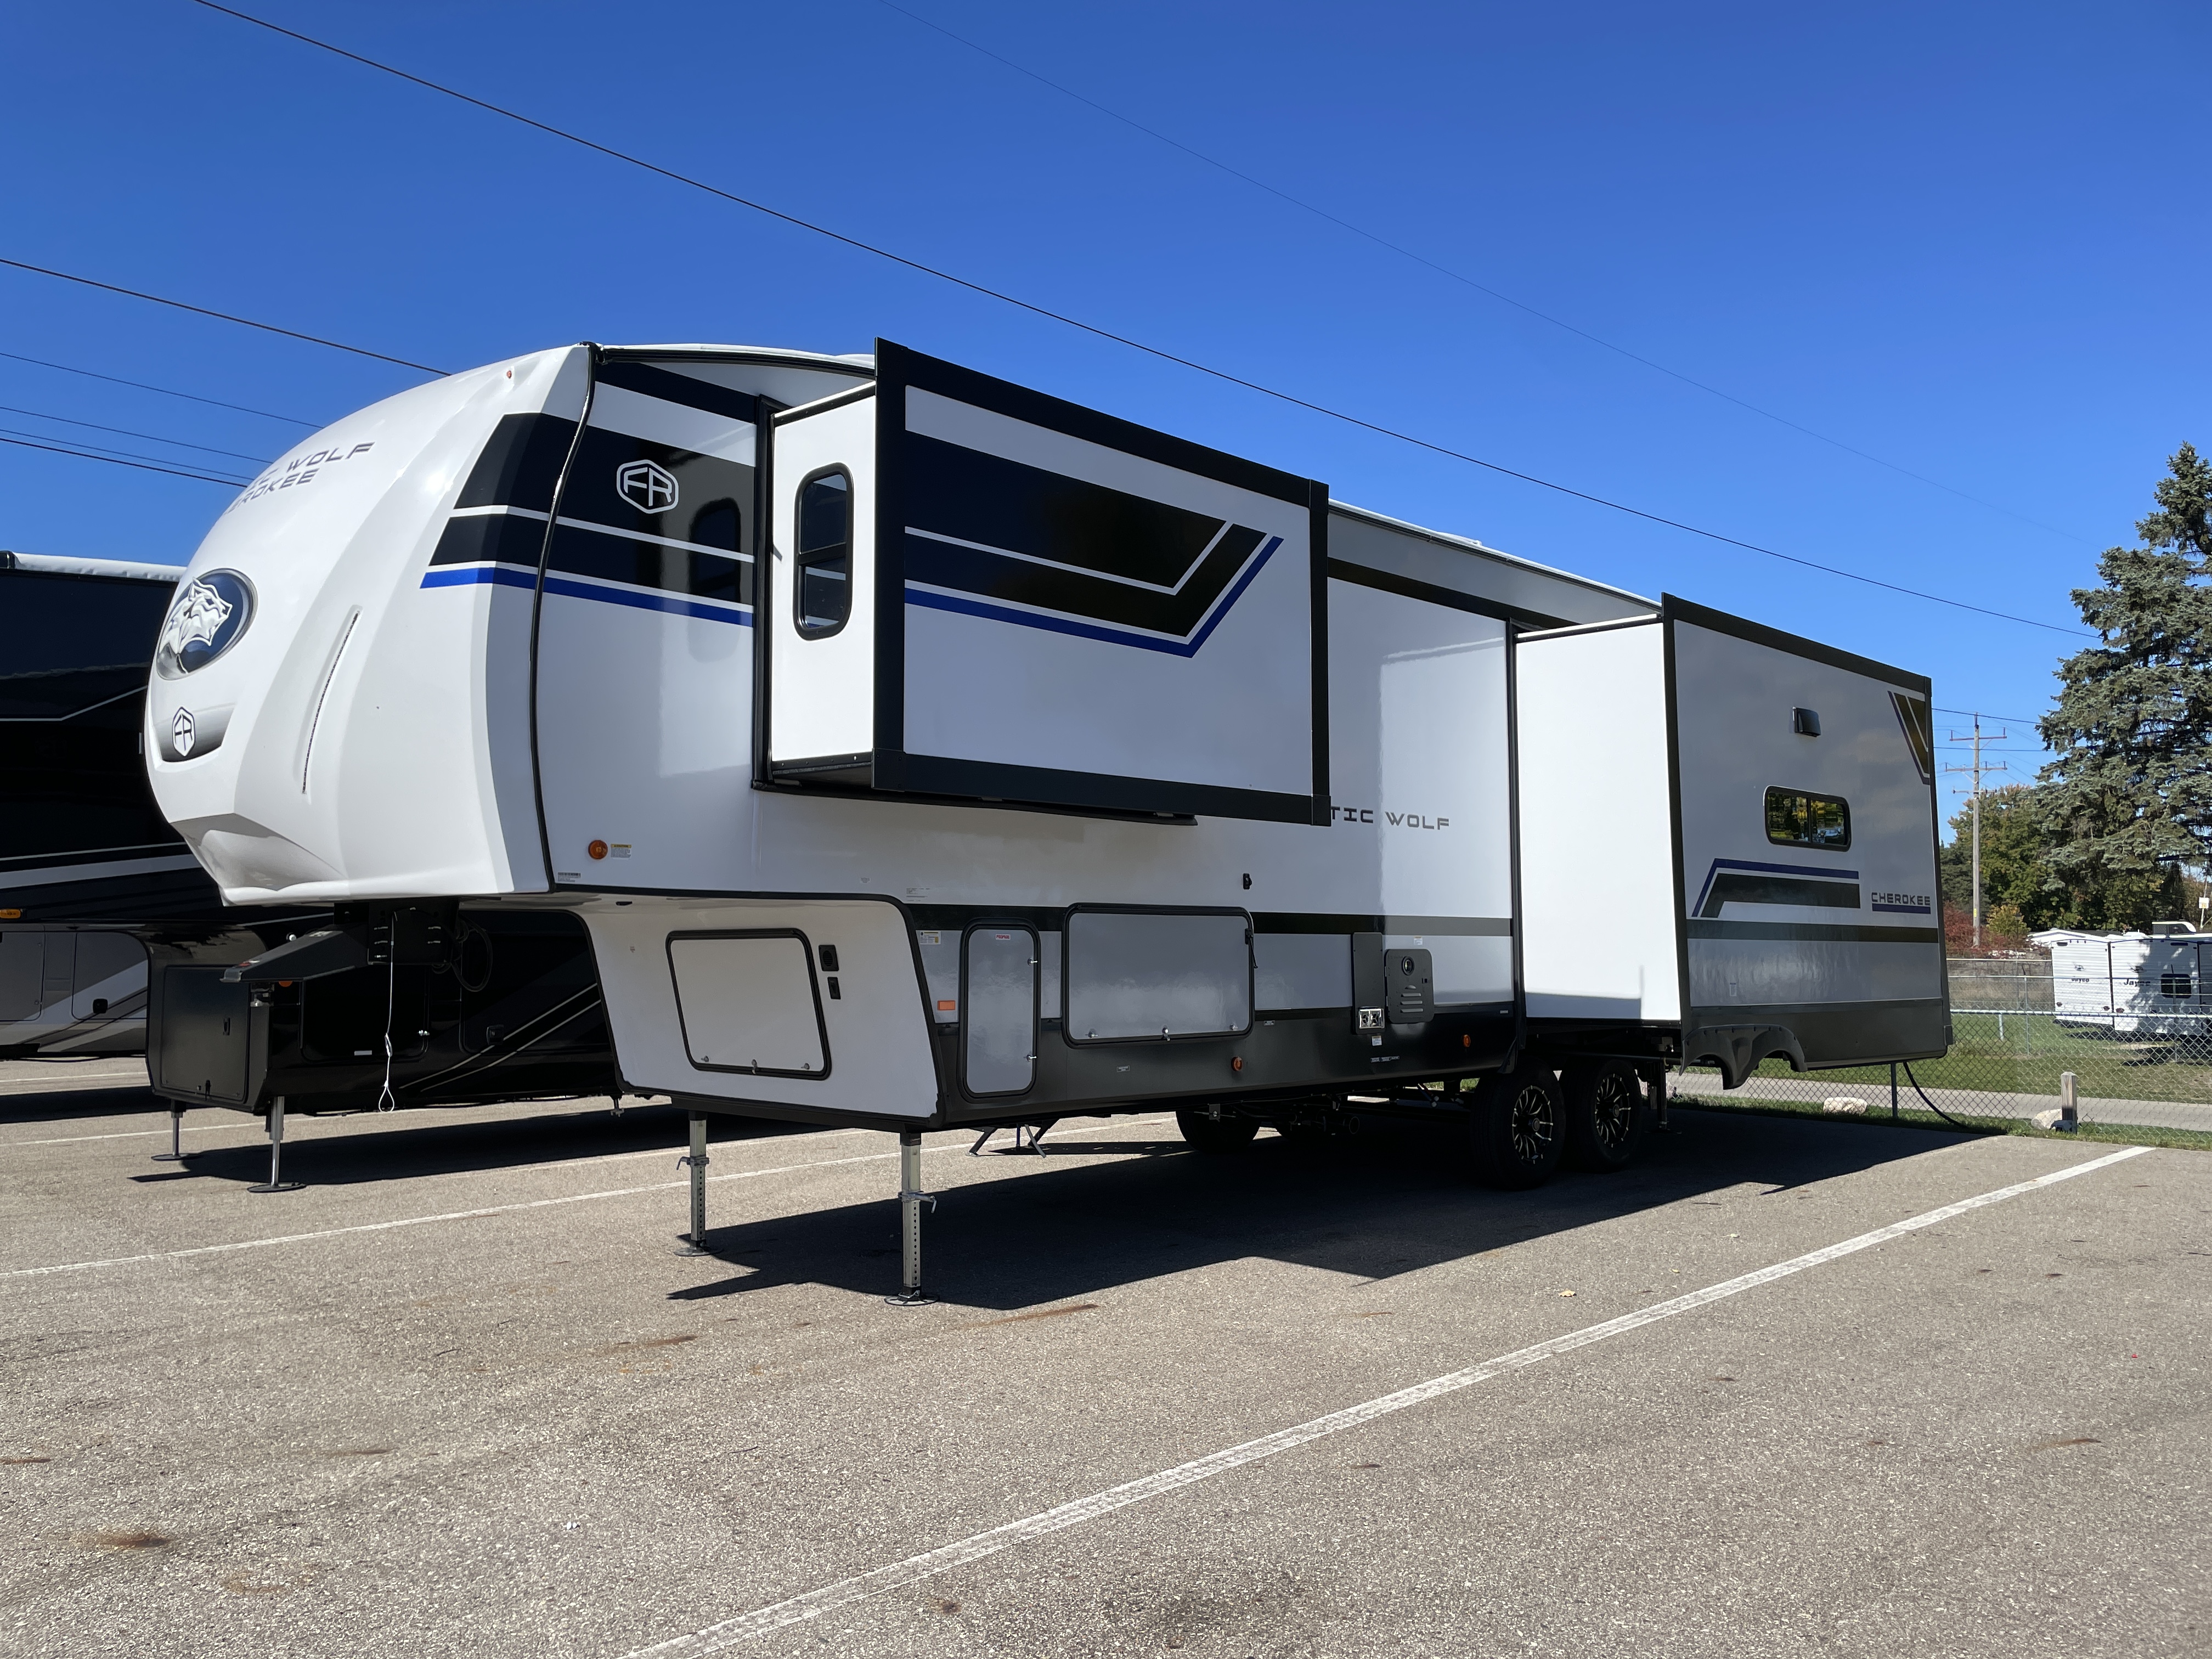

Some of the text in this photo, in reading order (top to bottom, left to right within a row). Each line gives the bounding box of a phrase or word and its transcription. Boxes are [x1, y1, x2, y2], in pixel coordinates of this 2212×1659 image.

[286, 441, 376, 473] WOLF
[1331, 806, 1449, 830] TIC WOLF
[1871, 891, 1931, 906] CHEROKEE
